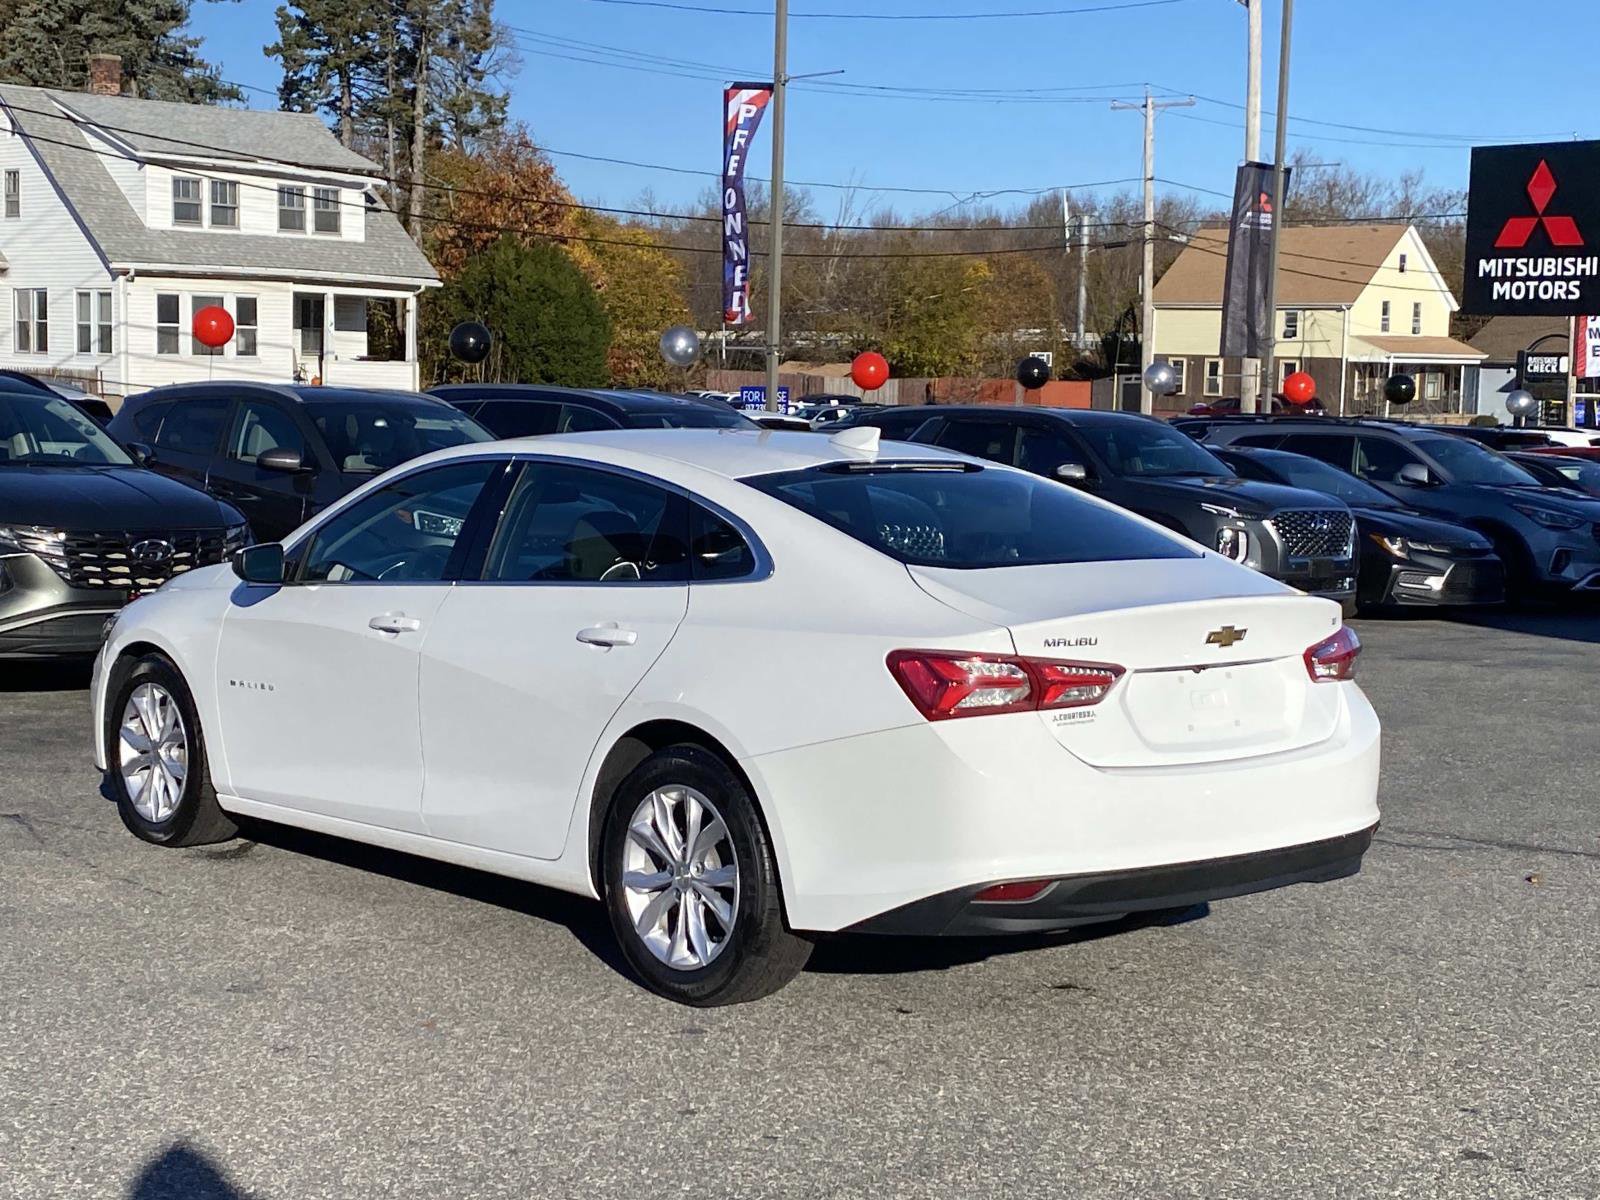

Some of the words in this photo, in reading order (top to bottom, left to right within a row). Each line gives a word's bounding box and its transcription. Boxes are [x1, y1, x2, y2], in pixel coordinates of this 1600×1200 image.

[1478, 256, 1598, 278] MITSUBISHI
[1492, 280, 1581, 300] MOTORS
[1527, 363, 1558, 373] CHECK
[742, 390, 760, 402] FOR
[761, 391, 787, 403] LSE
[1043, 636, 1098, 647] MALIBU
[230, 680, 274, 691] MALIBU
